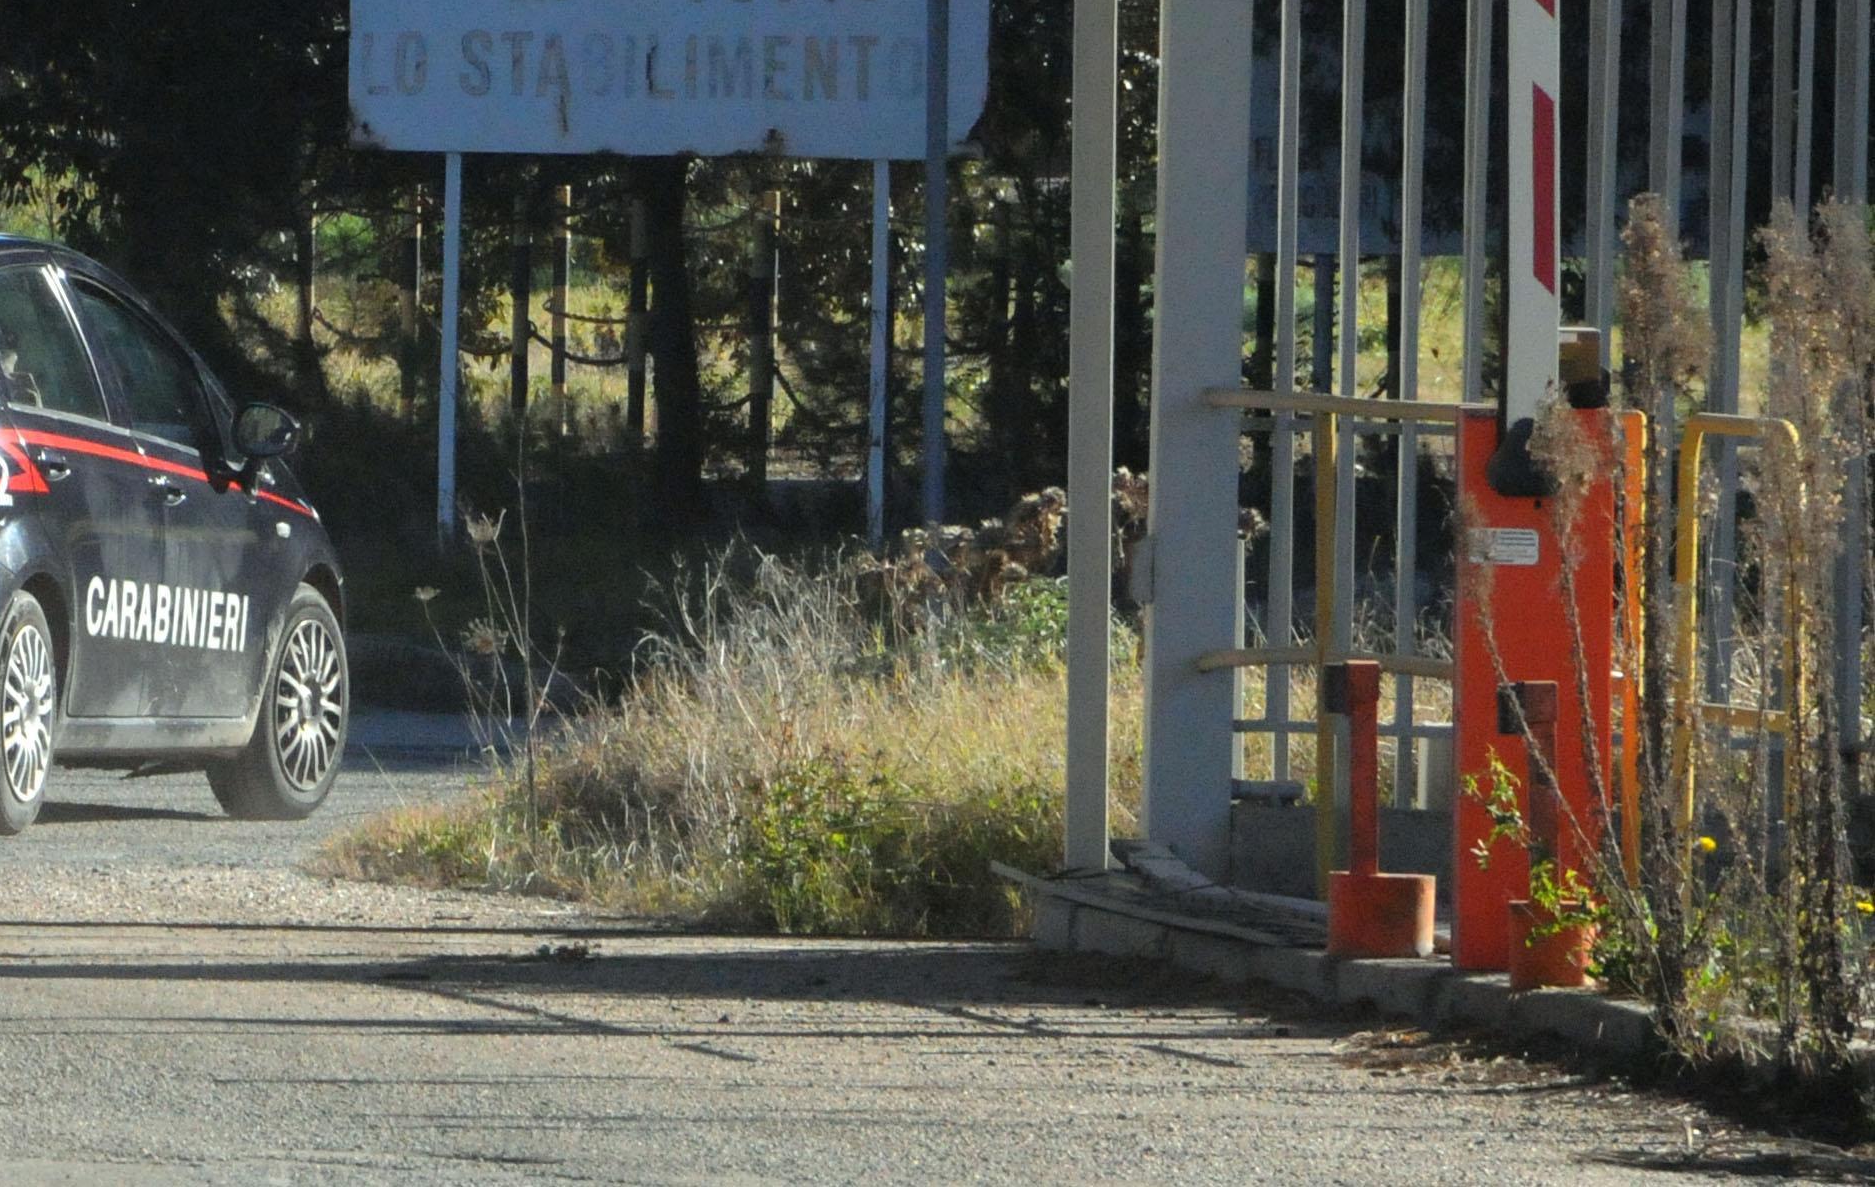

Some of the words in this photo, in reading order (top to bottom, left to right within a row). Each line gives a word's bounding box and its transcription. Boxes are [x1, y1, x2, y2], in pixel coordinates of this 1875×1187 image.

[362, 31, 429, 95] LO
[459, 28, 925, 100] STABILIMENTO
[85, 575, 249, 652] CARABINIERI
